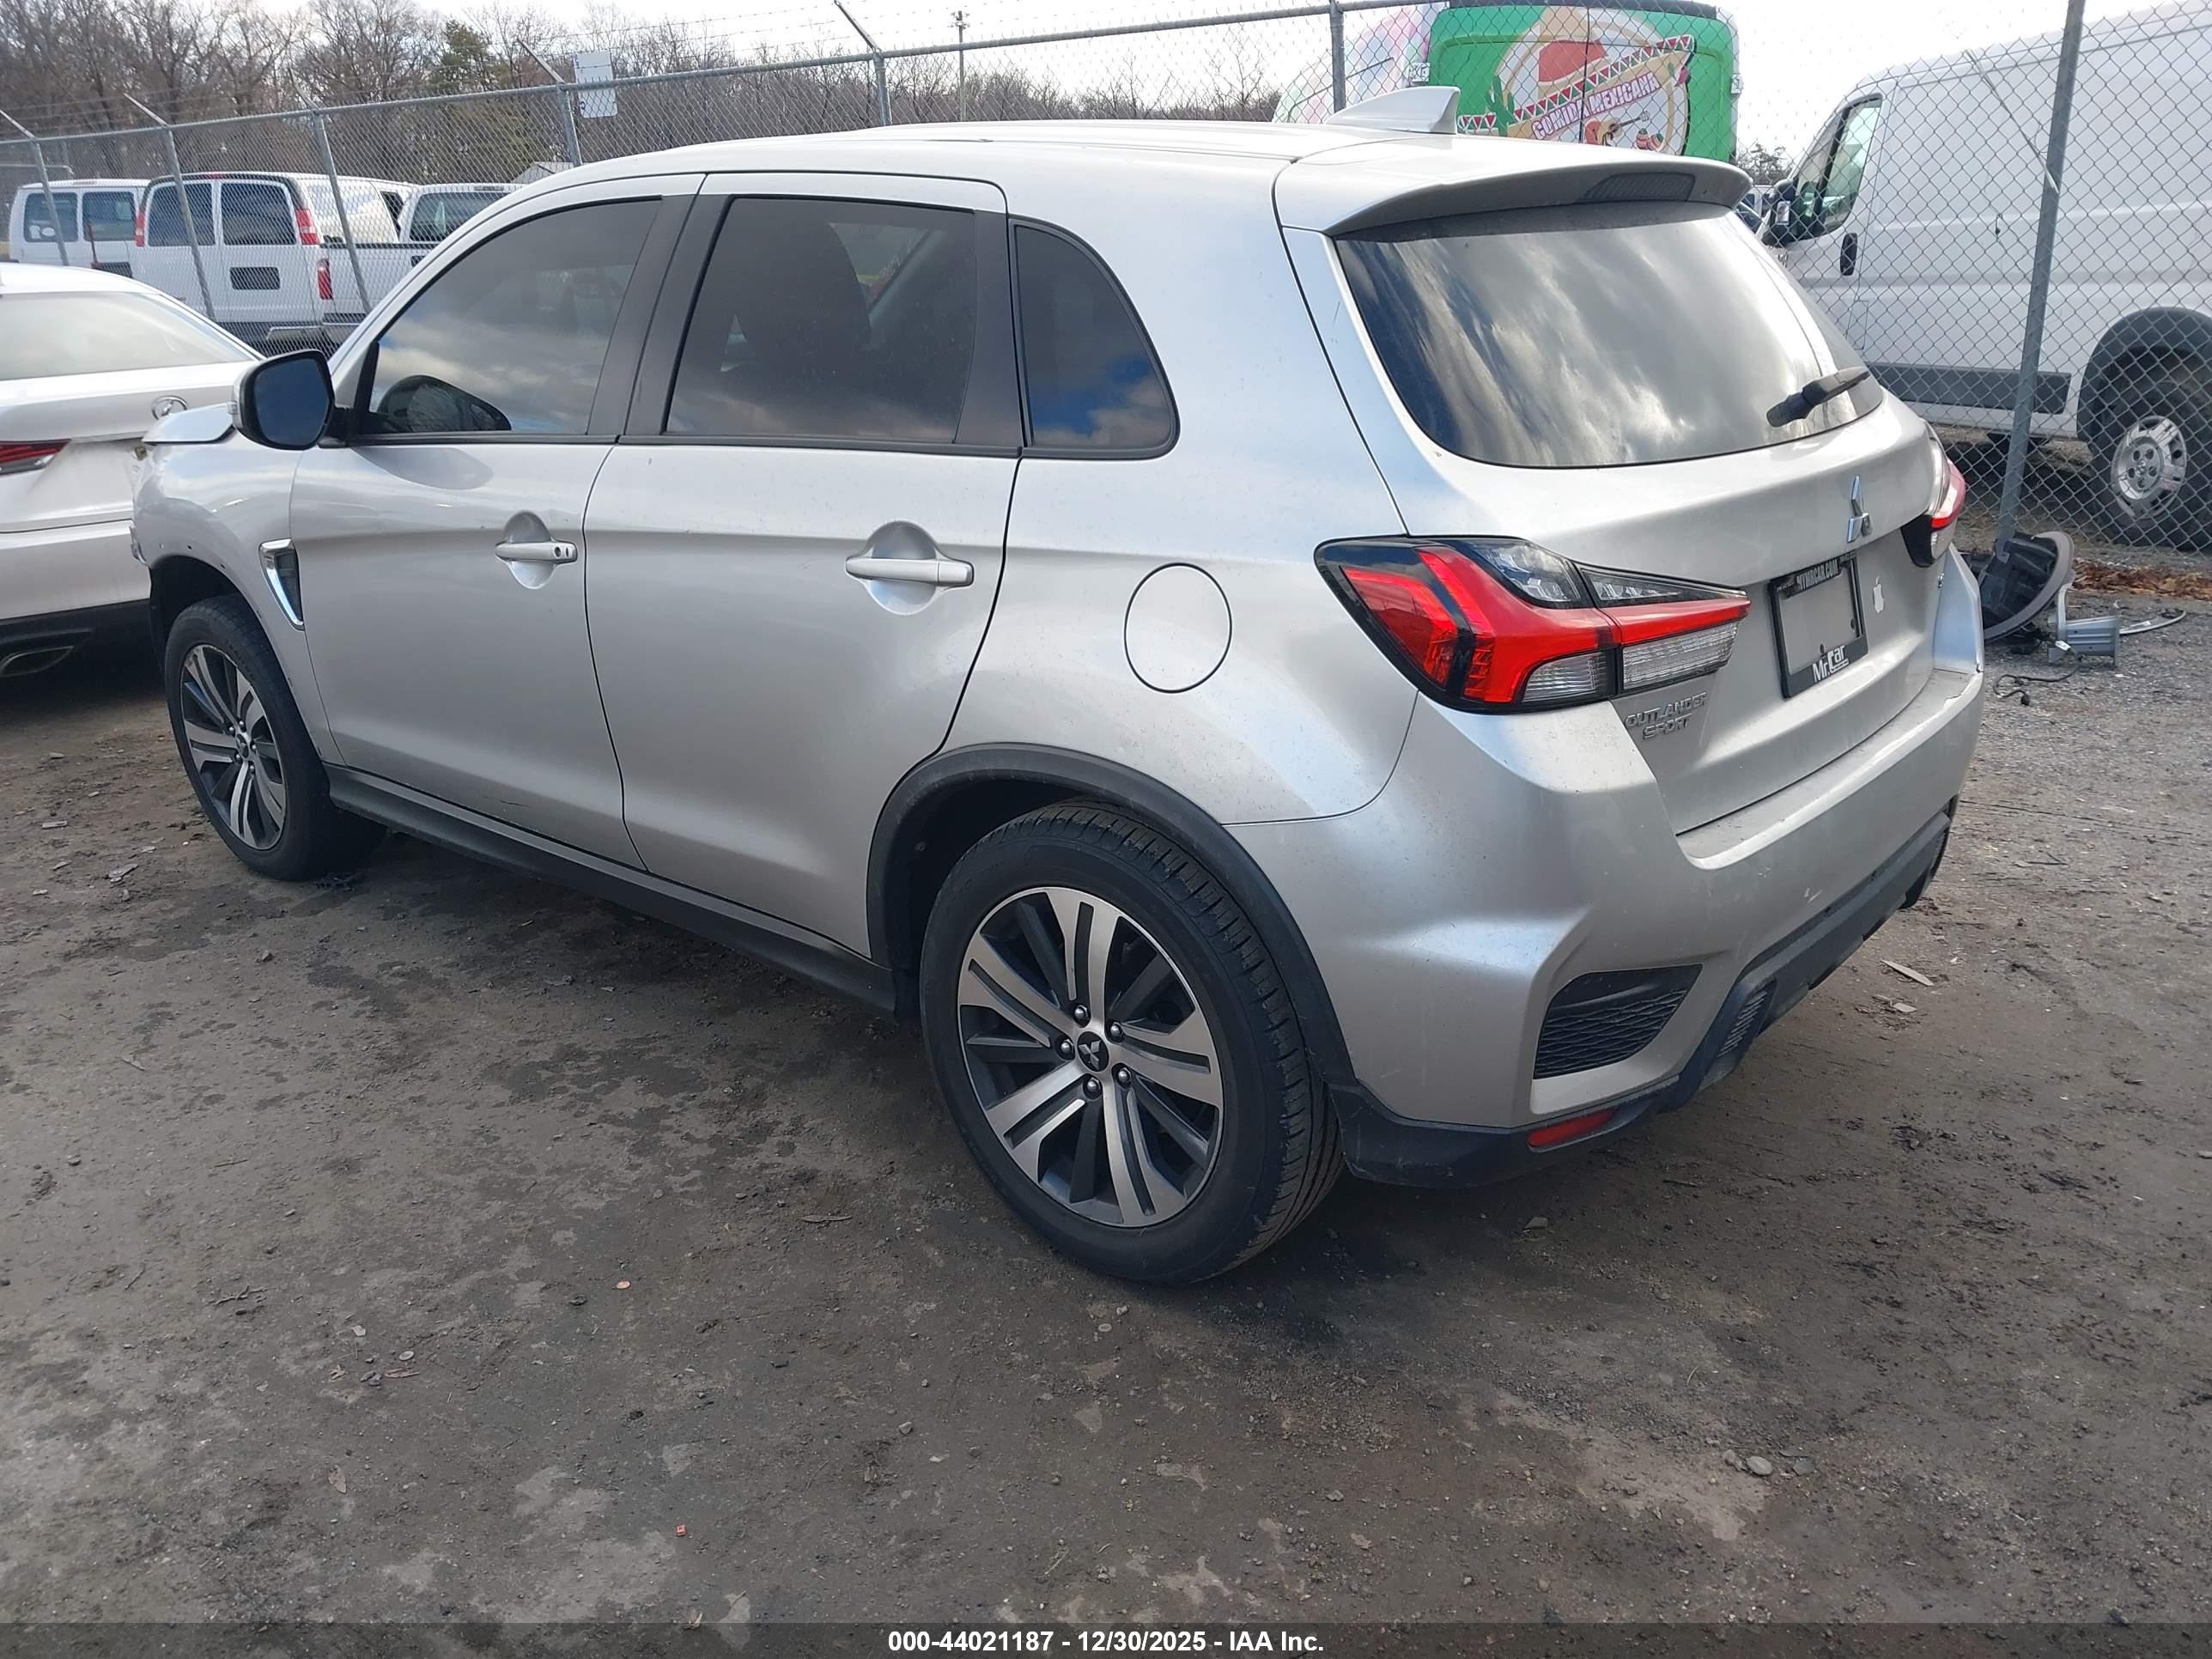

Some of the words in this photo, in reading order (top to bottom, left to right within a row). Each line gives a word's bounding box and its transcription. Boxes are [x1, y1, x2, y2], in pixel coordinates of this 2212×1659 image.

[1531, 99, 1590, 140] COMIDA
[1588, 71, 1662, 116] MEXICANA
[1624, 691, 1708, 727] OUTLANDER
[1643, 712, 1693, 740] SPORT
